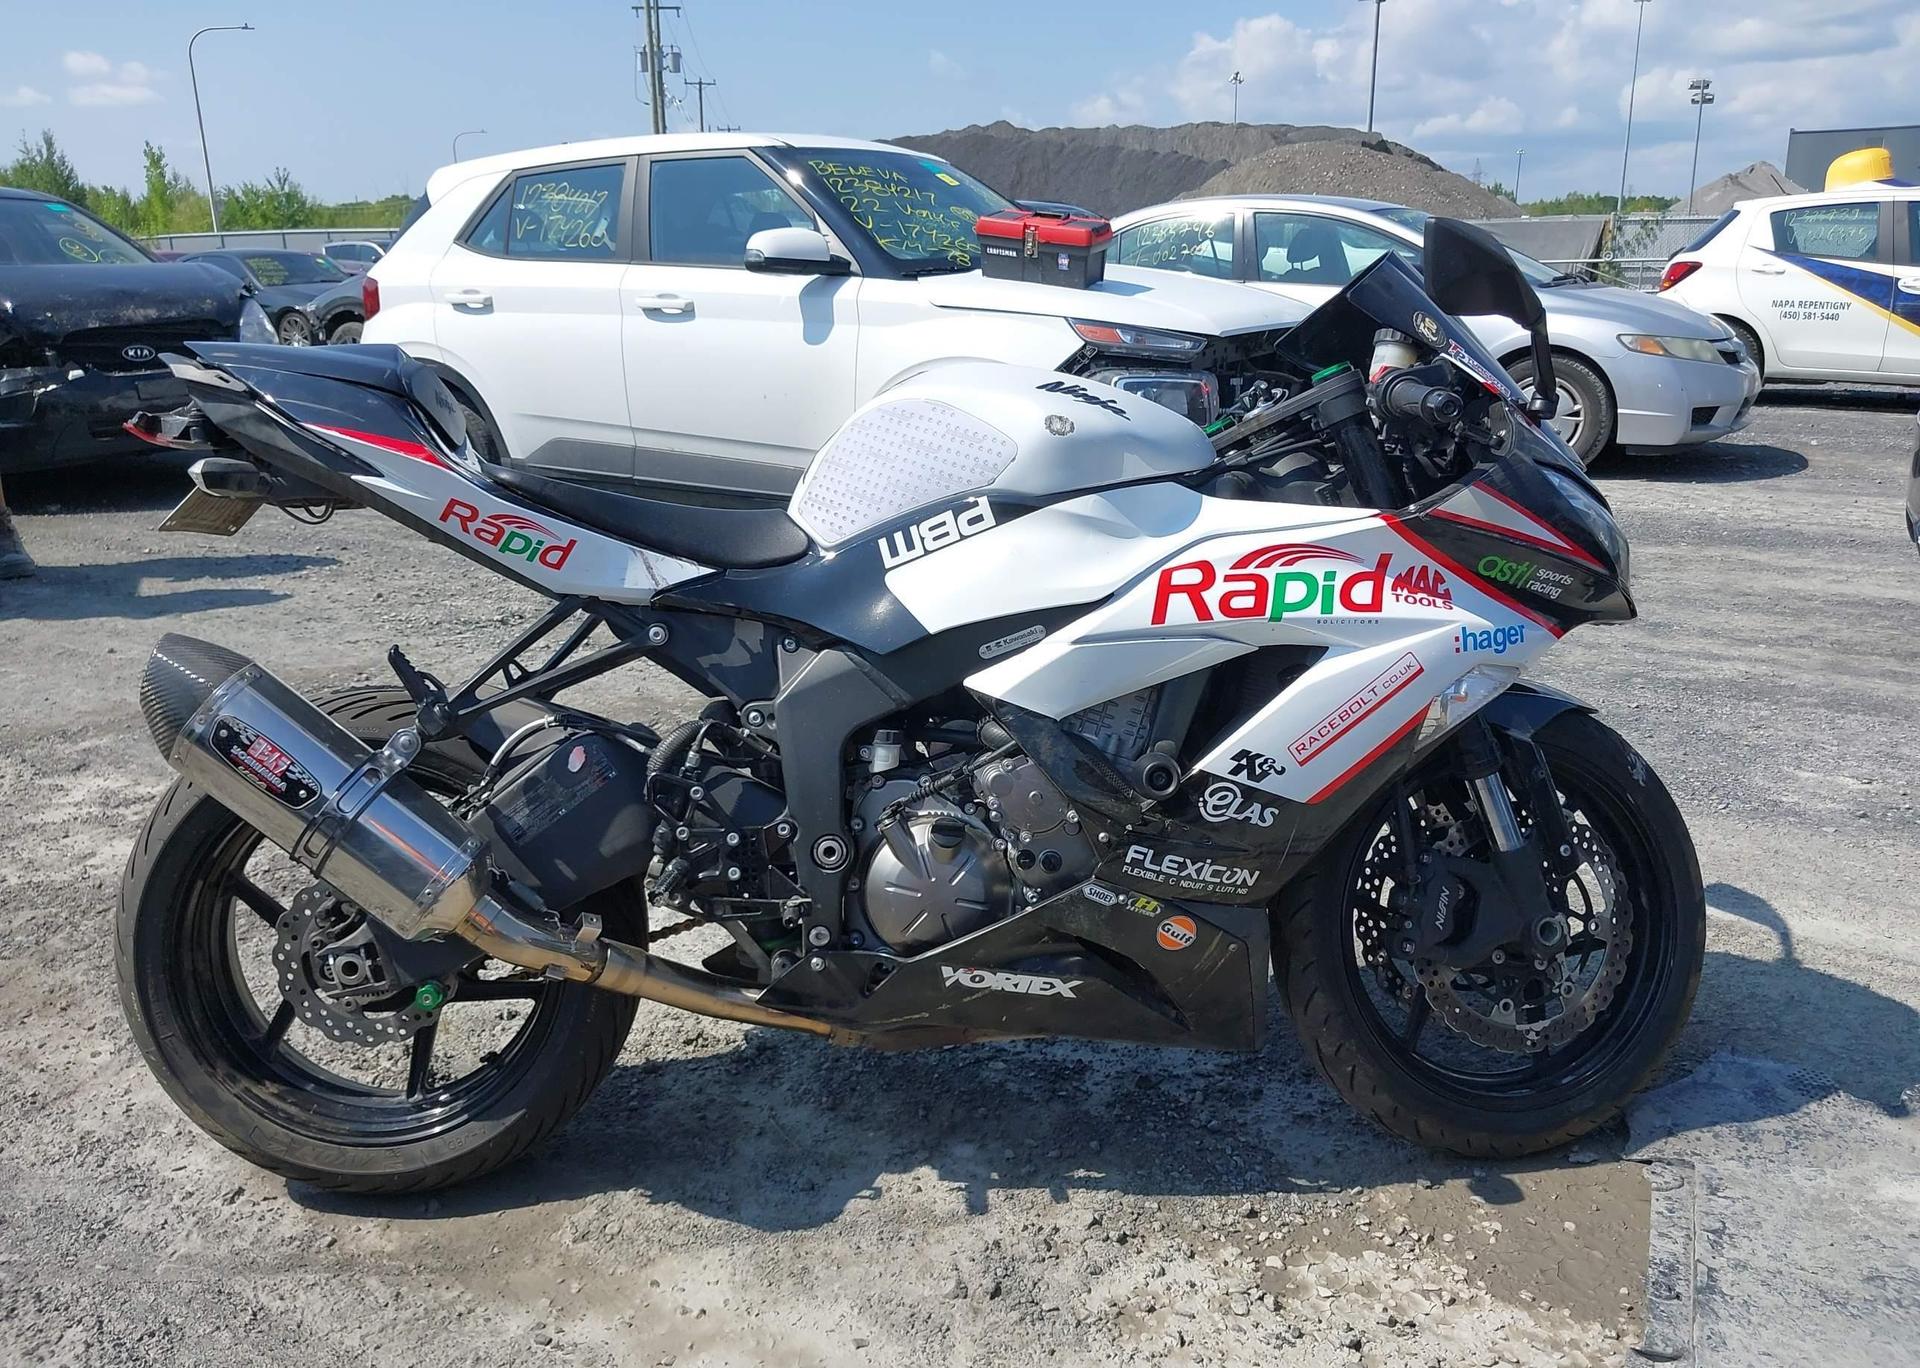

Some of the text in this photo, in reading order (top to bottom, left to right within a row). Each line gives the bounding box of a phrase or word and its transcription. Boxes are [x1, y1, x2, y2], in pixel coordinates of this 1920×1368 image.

[1771, 299, 1853, 311] NAPA REPENTIGNY
[1779, 310, 1840, 322] (450) 581-5440
[127, 348, 150, 358] KIA
[438, 497, 578, 572] Rapid
[1391, 564, 1454, 601] MAC
[1536, 568, 1574, 586] sports
[1150, 552, 1395, 626] Rapid
[1526, 579, 1562, 600] racing
[1391, 592, 1454, 611] TOOLS
[1294, 684, 1380, 756] RACEBOLT
[230, 744, 287, 792] YOSHIMURA
[1122, 865, 1166, 883] FLEXIBLE
[1087, 887, 1113, 903] SHOEI
[1160, 921, 1194, 946] Gulf
[940, 965, 1085, 999] VORTEX
